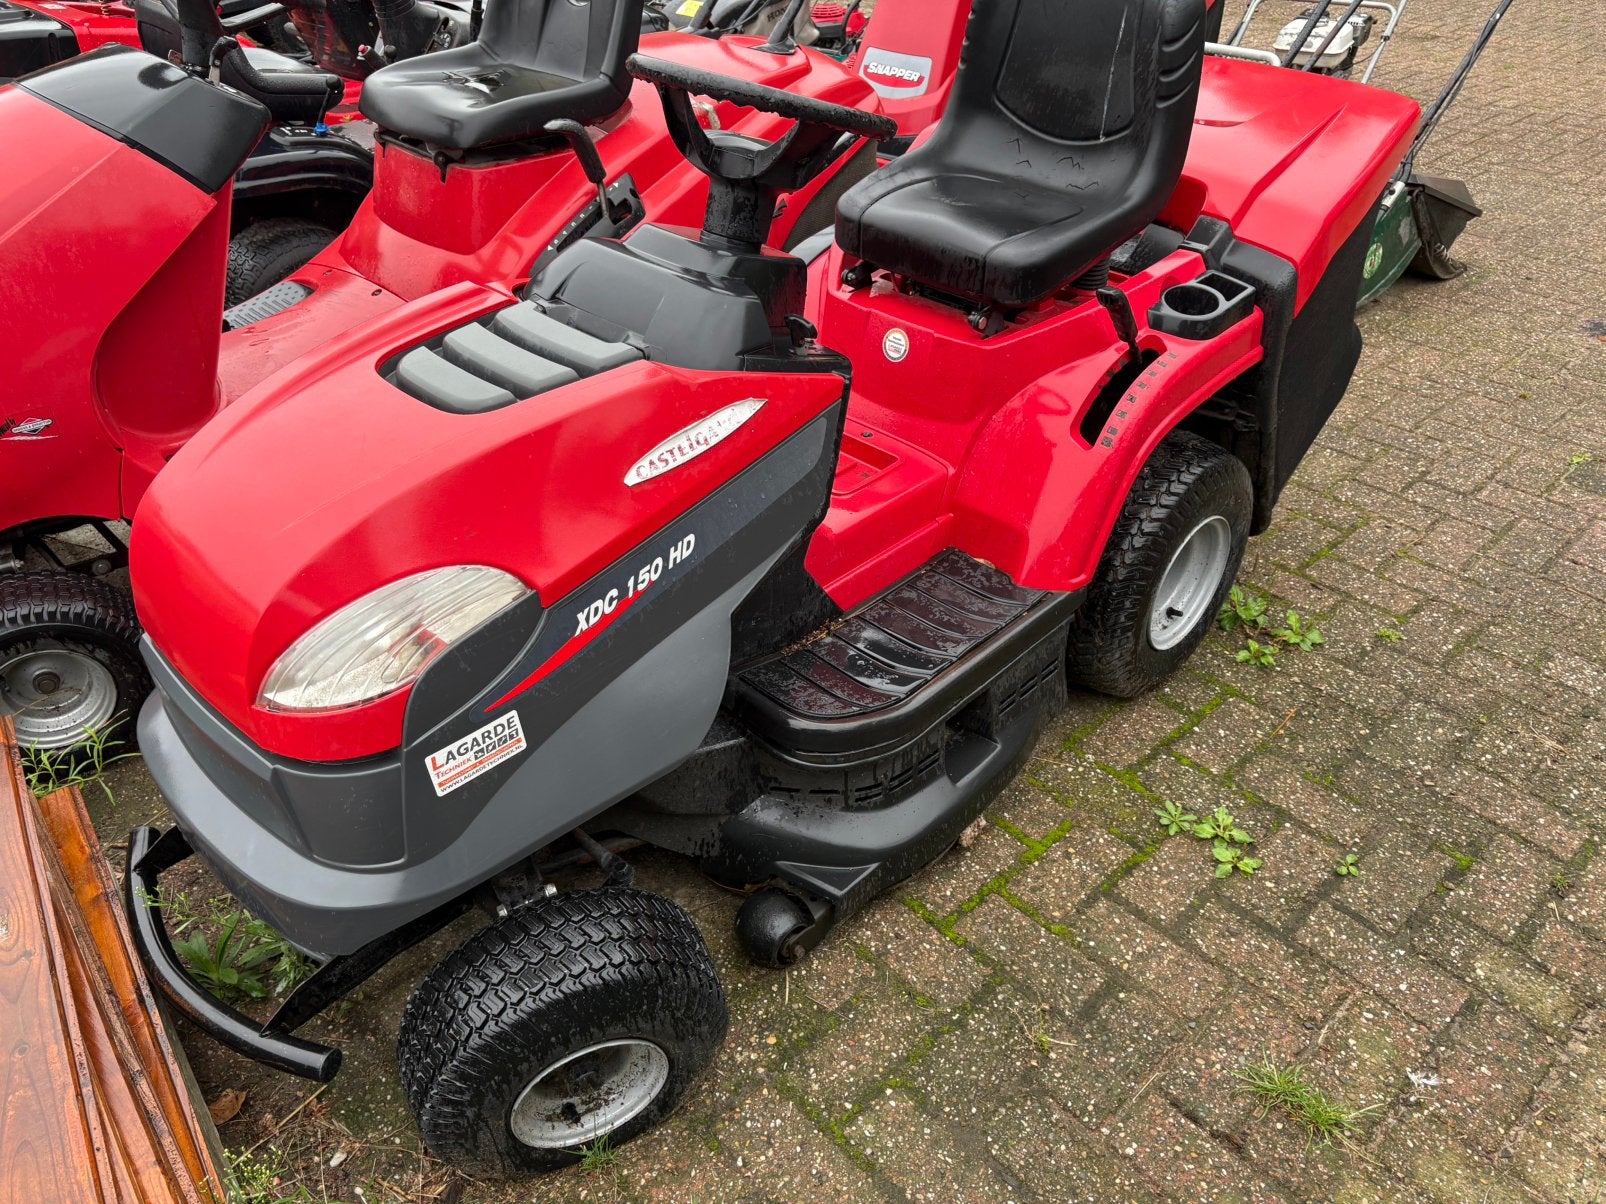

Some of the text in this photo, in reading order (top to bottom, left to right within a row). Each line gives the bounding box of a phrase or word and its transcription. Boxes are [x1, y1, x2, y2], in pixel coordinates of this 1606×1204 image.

[867, 61, 921, 82] SNAPPER
[575, 533, 696, 637] XDC 150 HD
[430, 715, 517, 772] LAGARDE
